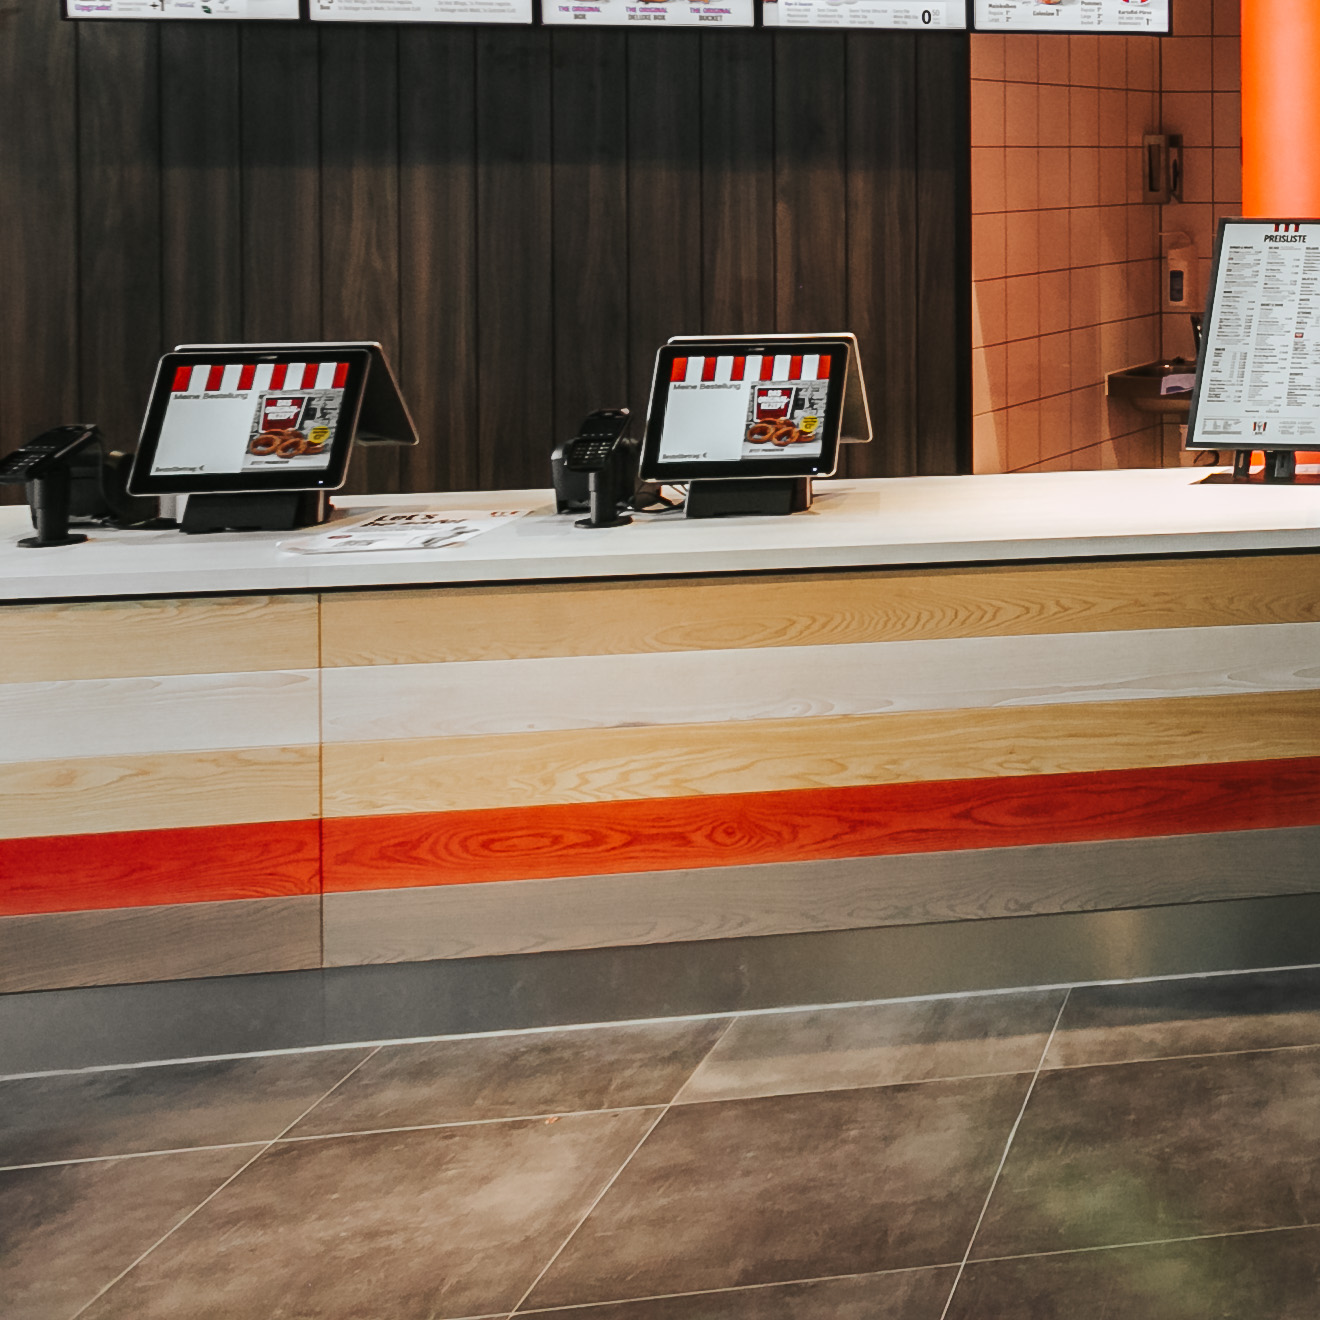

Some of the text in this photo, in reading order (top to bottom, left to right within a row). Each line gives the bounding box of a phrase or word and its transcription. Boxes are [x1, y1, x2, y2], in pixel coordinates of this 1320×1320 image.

[1264, 235, 1307, 243] PREISLISTE
[700, 382, 741, 390] Bestellung
[203, 392, 248, 400] Bestellung
